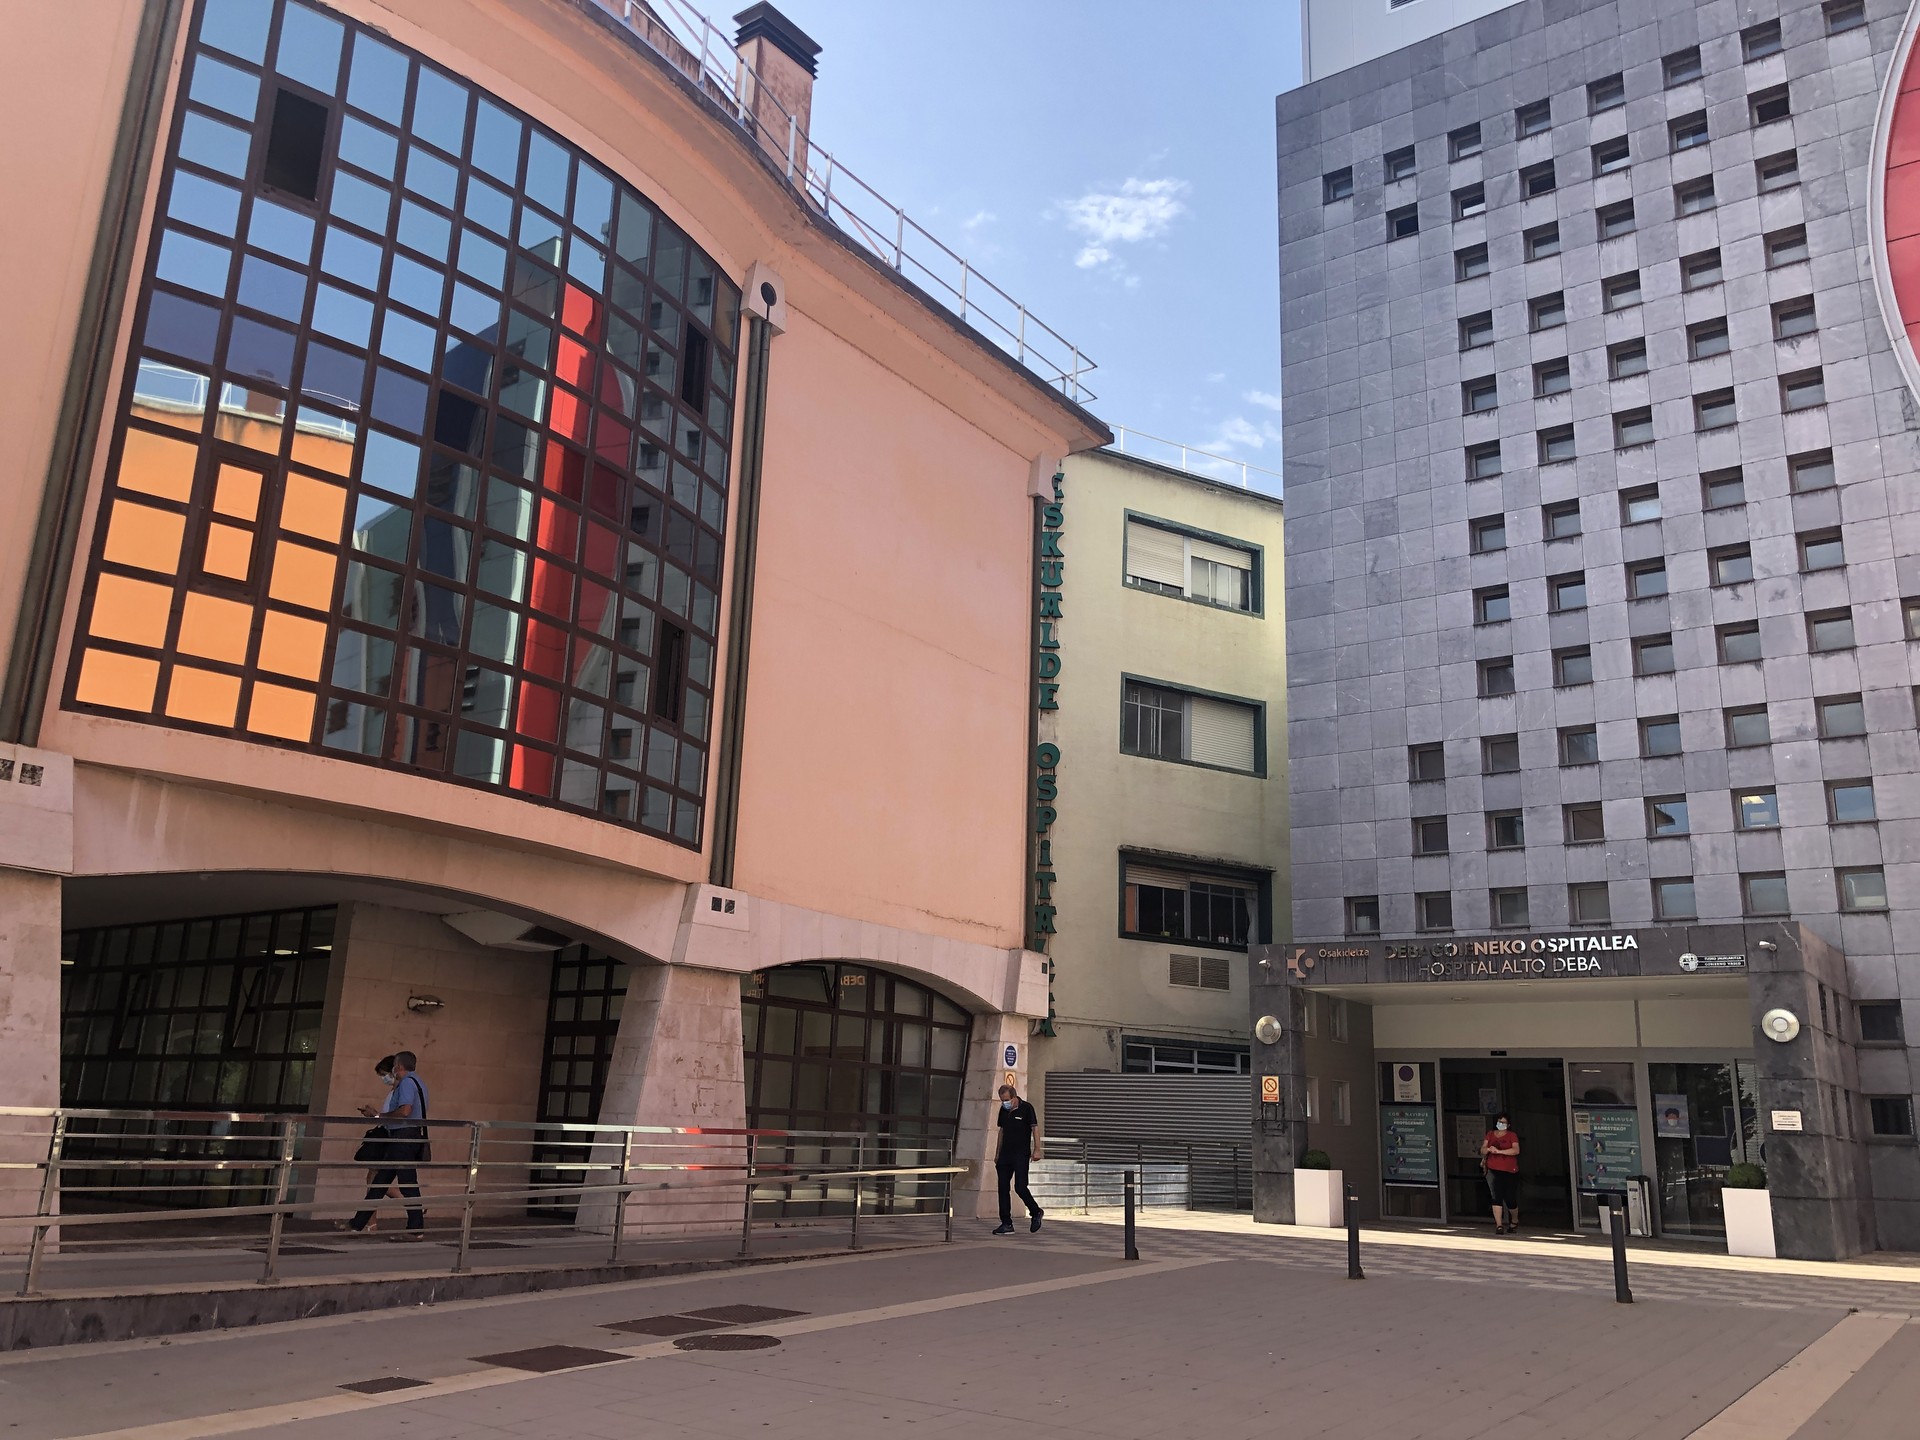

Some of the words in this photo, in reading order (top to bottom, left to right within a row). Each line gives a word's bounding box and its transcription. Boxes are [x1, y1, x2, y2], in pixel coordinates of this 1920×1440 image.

[1318, 948, 1370, 958] Osakidetza
[1530, 935, 1638, 953] OSPITALEA
[1419, 960, 1498, 976] HOSPITAL
[1501, 958, 1546, 974] ALTO
[1553, 956, 1602, 973] DEBA
